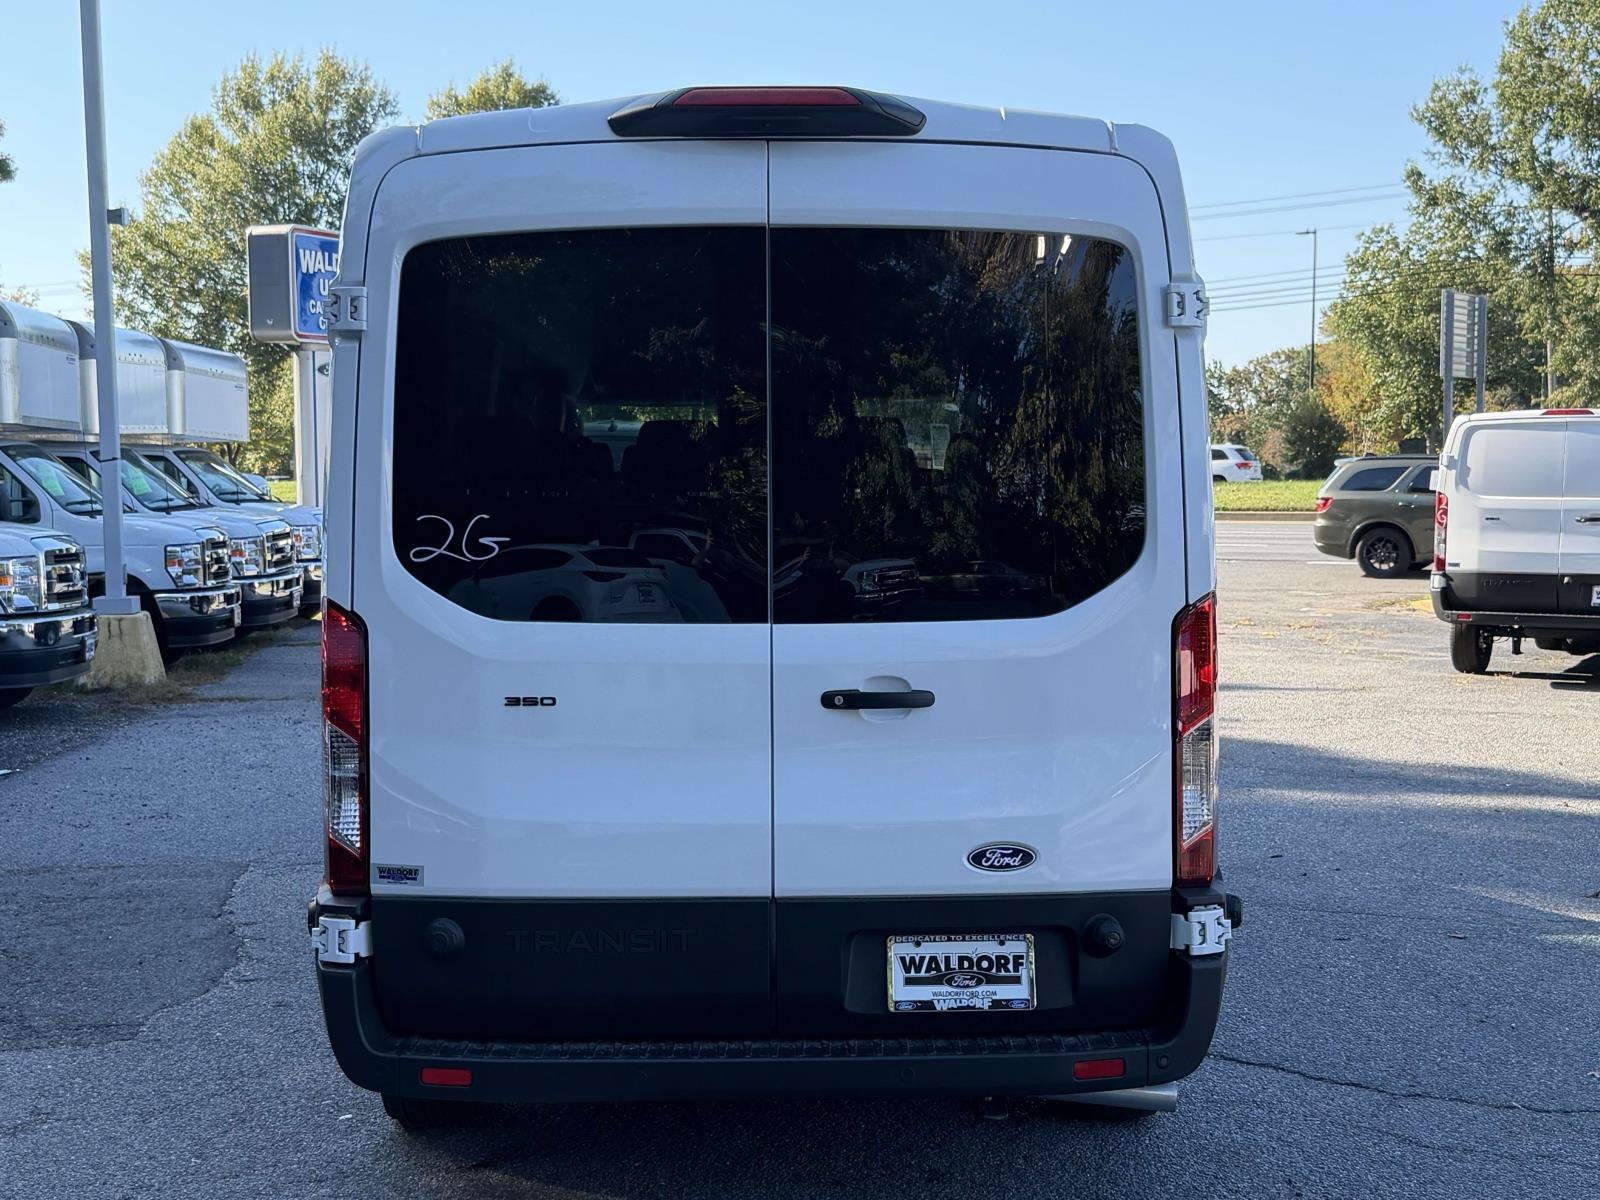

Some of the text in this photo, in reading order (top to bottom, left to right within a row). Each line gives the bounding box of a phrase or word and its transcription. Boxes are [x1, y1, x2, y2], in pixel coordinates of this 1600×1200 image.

[504, 696, 556, 706] 350
[981, 848, 1023, 866] Ford
[376, 866, 420, 876] WALDORF
[504, 928, 697, 952] TRANSIT
[897, 953, 1026, 975] WALDORF
[951, 974, 977, 987] Ford
[931, 990, 998, 998] WALDORFFORD.COM
[933, 998, 993, 1010] WALDORF
